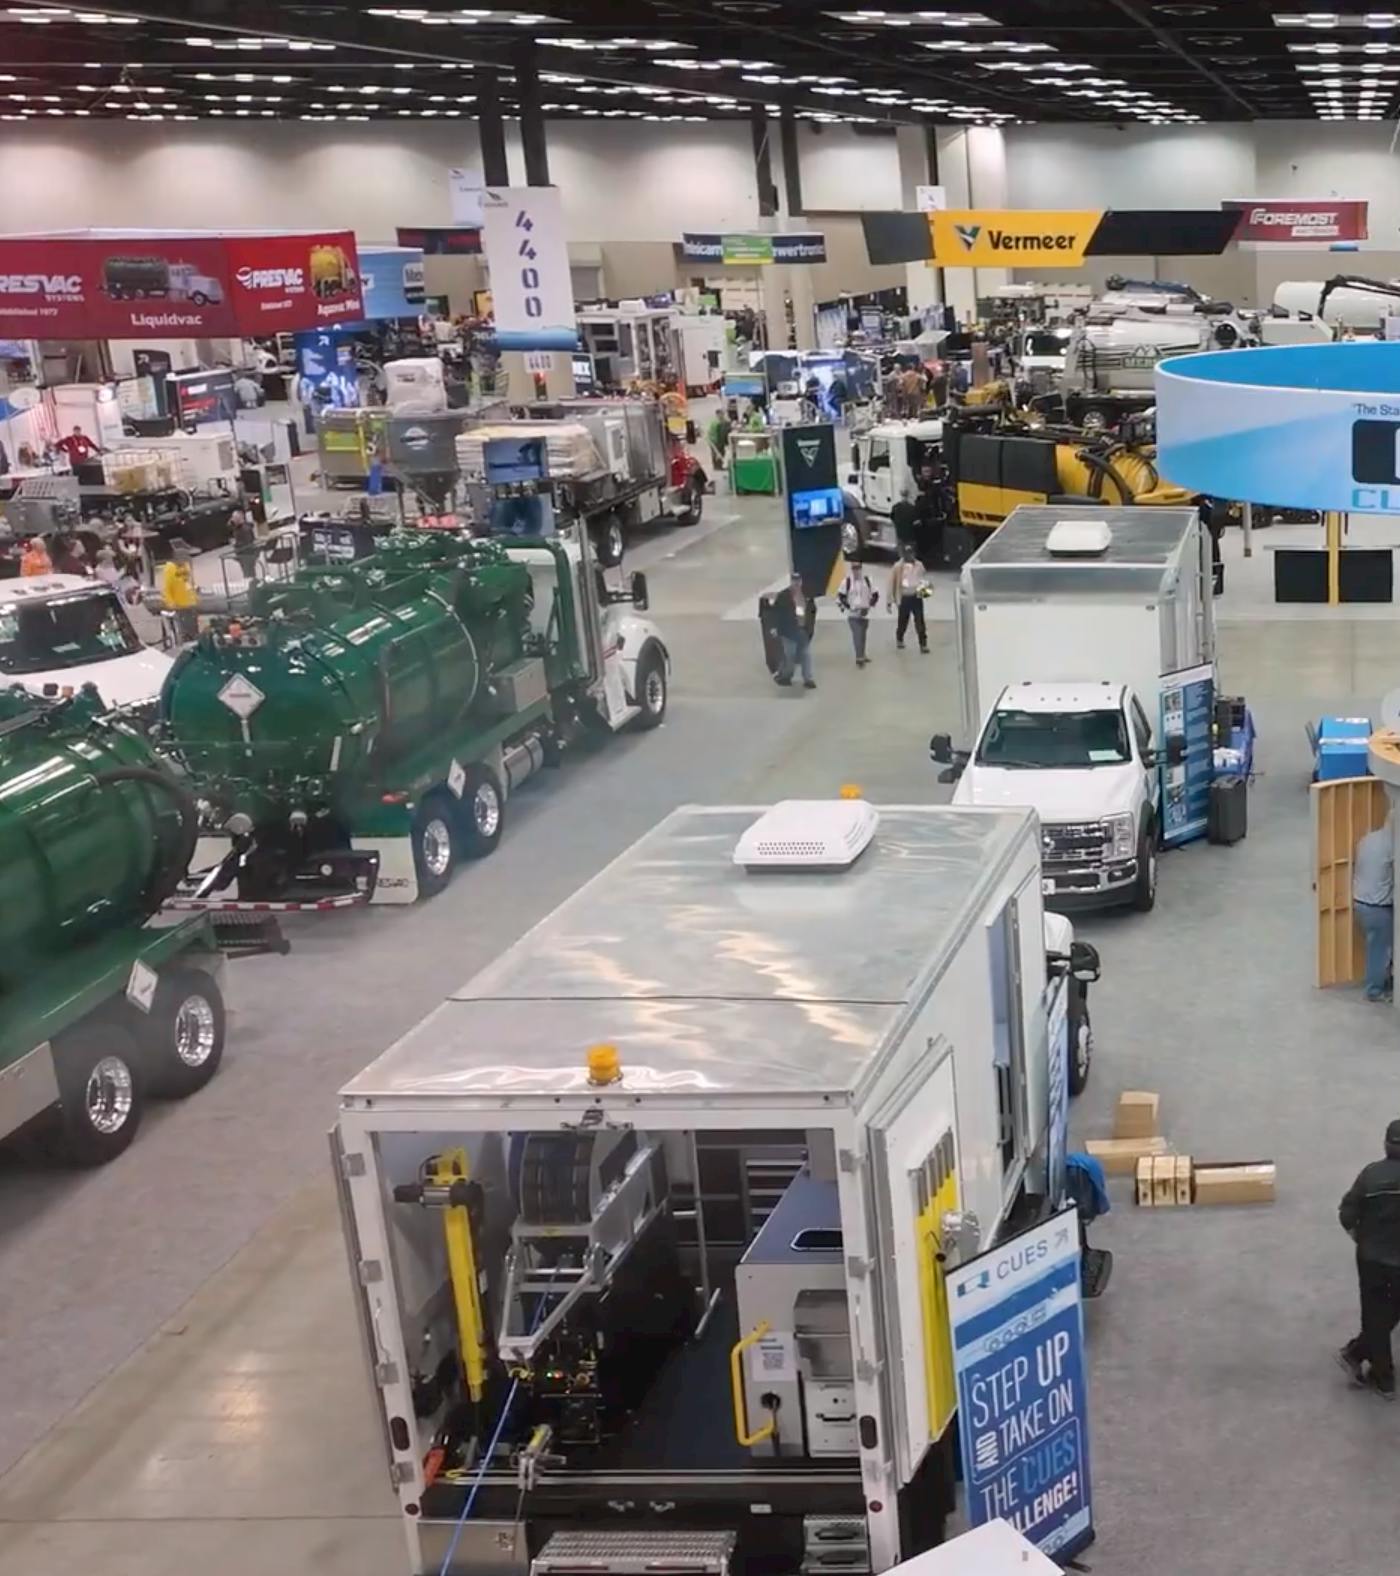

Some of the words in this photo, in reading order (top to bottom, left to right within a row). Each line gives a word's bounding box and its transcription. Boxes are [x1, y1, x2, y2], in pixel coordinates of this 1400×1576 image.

[988, 230, 1076, 251] Vermeer
[1250, 208, 1339, 226] FOREMOST
[252, 268, 304, 288] PRESVAC
[516, 210, 543, 318] 4400
[131, 313, 203, 328] Liquidvac
[996, 1240, 1049, 1280] CUES
[972, 1356, 1028, 1428] STEP
[1036, 1330, 1070, 1387] UP
[975, 1430, 1000, 1471] AND
[999, 1398, 1046, 1457] TAKE
[1047, 1378, 1073, 1426] ON
[980, 1466, 1020, 1523] THE
[1022, 1429, 1075, 1494] CUES
[1006, 1470, 1078, 1535] ALLENGE!
